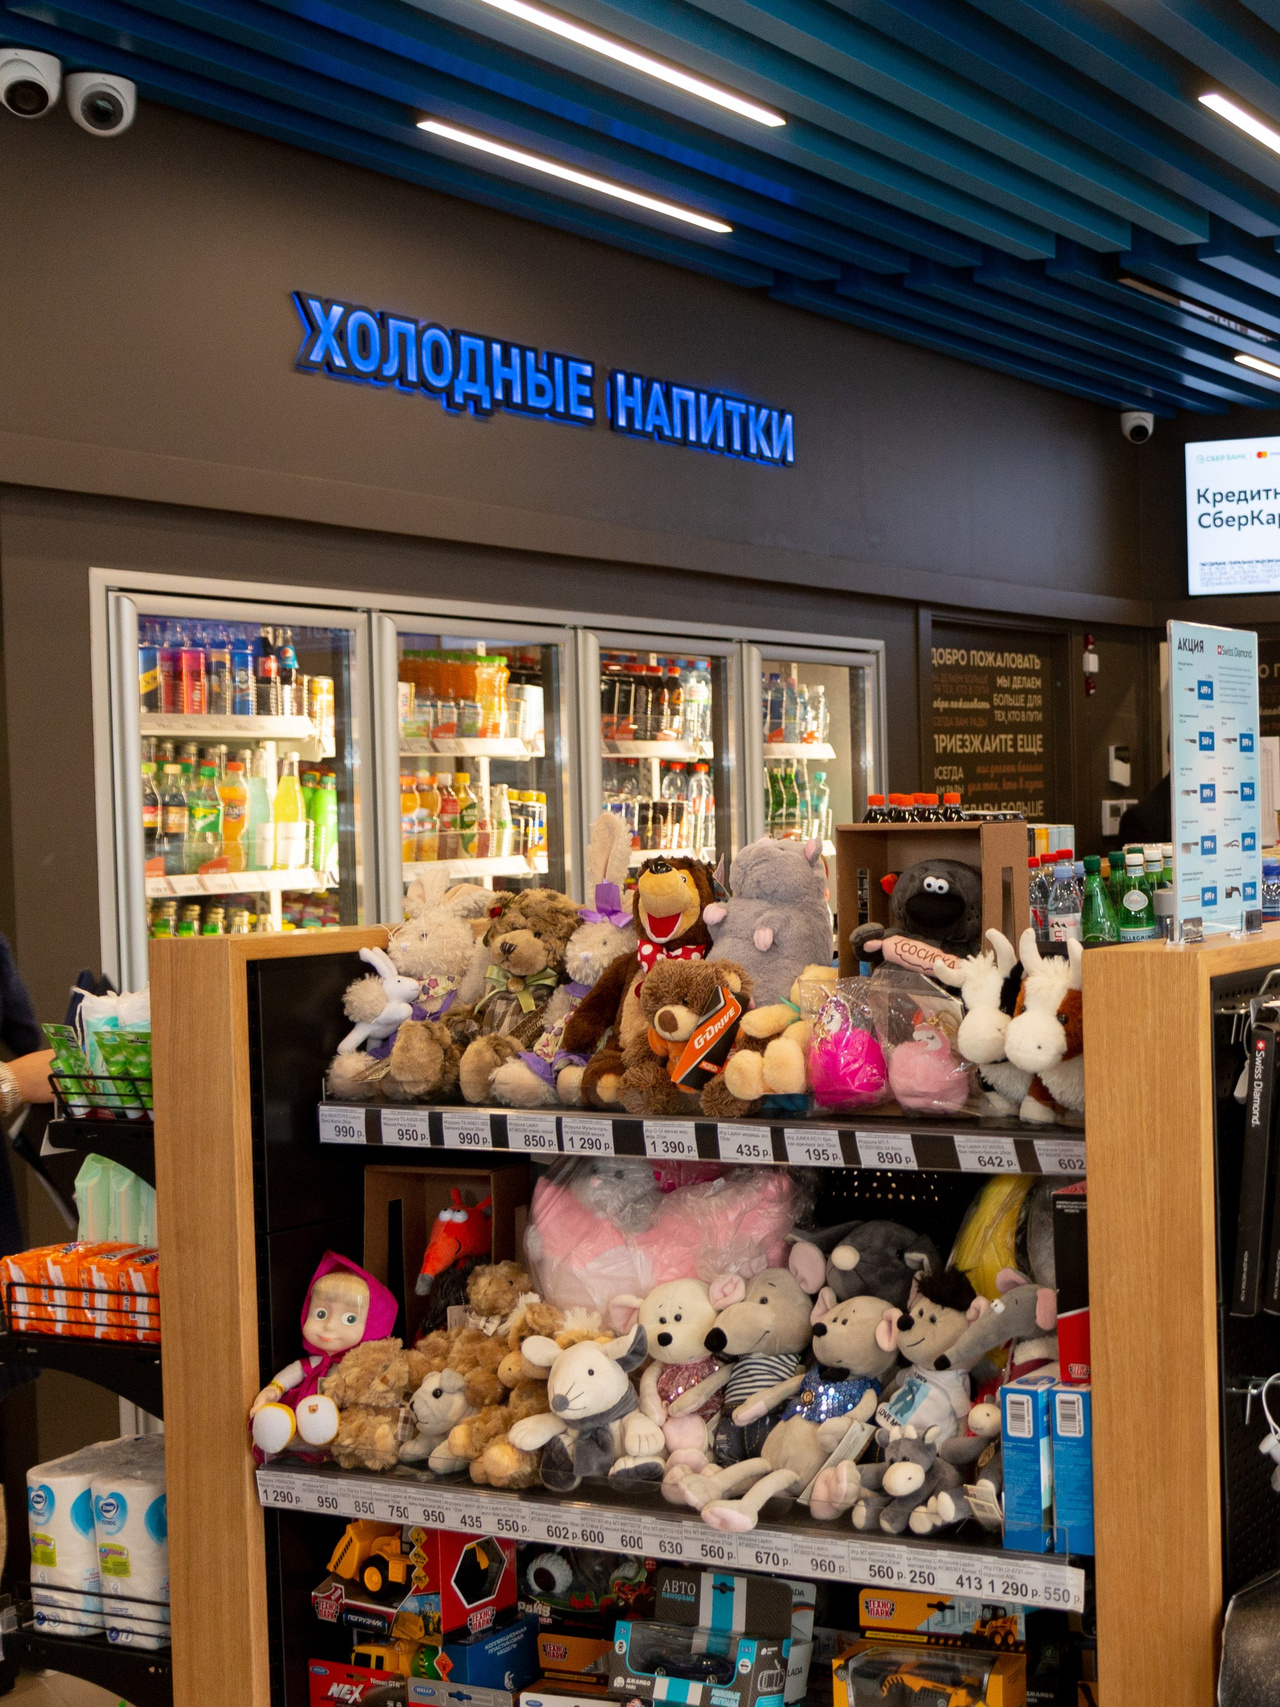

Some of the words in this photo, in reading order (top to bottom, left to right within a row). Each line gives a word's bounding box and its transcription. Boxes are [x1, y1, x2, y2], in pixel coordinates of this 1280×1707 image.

[294, 293, 596, 422] ХОЛОДНЫЕ
[609, 370, 795, 464] НАПИТКИ
[1178, 637, 1204, 653] АКЦИЯ
[1222, 646, 1234, 656] Swiss
[1234, 647, 1253, 658] Diamond
[969, 650, 1041, 669] ПОЖАЛОВАТЬ
[996, 675, 1011, 688] МЫ
[1011, 676, 1042, 690] ДЕЛАЕМ
[993, 693, 1025, 707] БОЛЬШЕ
[1027, 695, 1042, 708] ДЛЯ
[1017, 734, 1043, 755] ЕЩЕ
[1254, 1050, 1265, 1079] Swiss
[334, 1125, 355, 1138] 990
[397, 1128, 418, 1141] 950
[458, 1132, 480, 1145] 990
[524, 1134, 545, 1147] 850
[579, 1137, 601, 1150] 290
[662, 1141, 684, 1153] 390
[736, 1144, 760, 1157] 435
[805, 1148, 830, 1161] 195
[877, 1152, 902, 1164] 890
[978, 1156, 1004, 1167] 642
[1058, 1158, 1086, 1170] 602
[274, 1491, 294, 1503] 290
[317, 1496, 338, 1510] 950
[354, 1500, 374, 1514] 850
[388, 1505, 409, 1519] 750
[423, 1509, 445, 1523] 950
[460, 1514, 482, 1528] 435
[497, 1518, 519, 1533] 550
[546, 1525, 569, 1539] 602
[581, 1529, 604, 1544] 600
[620, 1535, 643, 1549] 600
[659, 1540, 683, 1554] 630
[701, 1544, 725, 1559] 560
[755, 1550, 779, 1565] 670
[810, 1558, 836, 1573] 960
[868, 1564, 894, 1579] 560
[909, 1569, 935, 1585] 250
[956, 1574, 982, 1590] 413
[662, 1579, 696, 1596] АВТО
[1001, 1580, 1028, 1597] 290
[1043, 1586, 1070, 1603] 550
[662, 1591, 695, 1602] панорама
[868, 1600, 892, 1611] ТЕХНО
[869, 1608, 890, 1618] ПАРК
[348, 1614, 383, 1627] ПОГРУЗЧИК
[787, 1667, 803, 1677] LADA
[626, 1677, 651, 1687] ДЖАМБО
